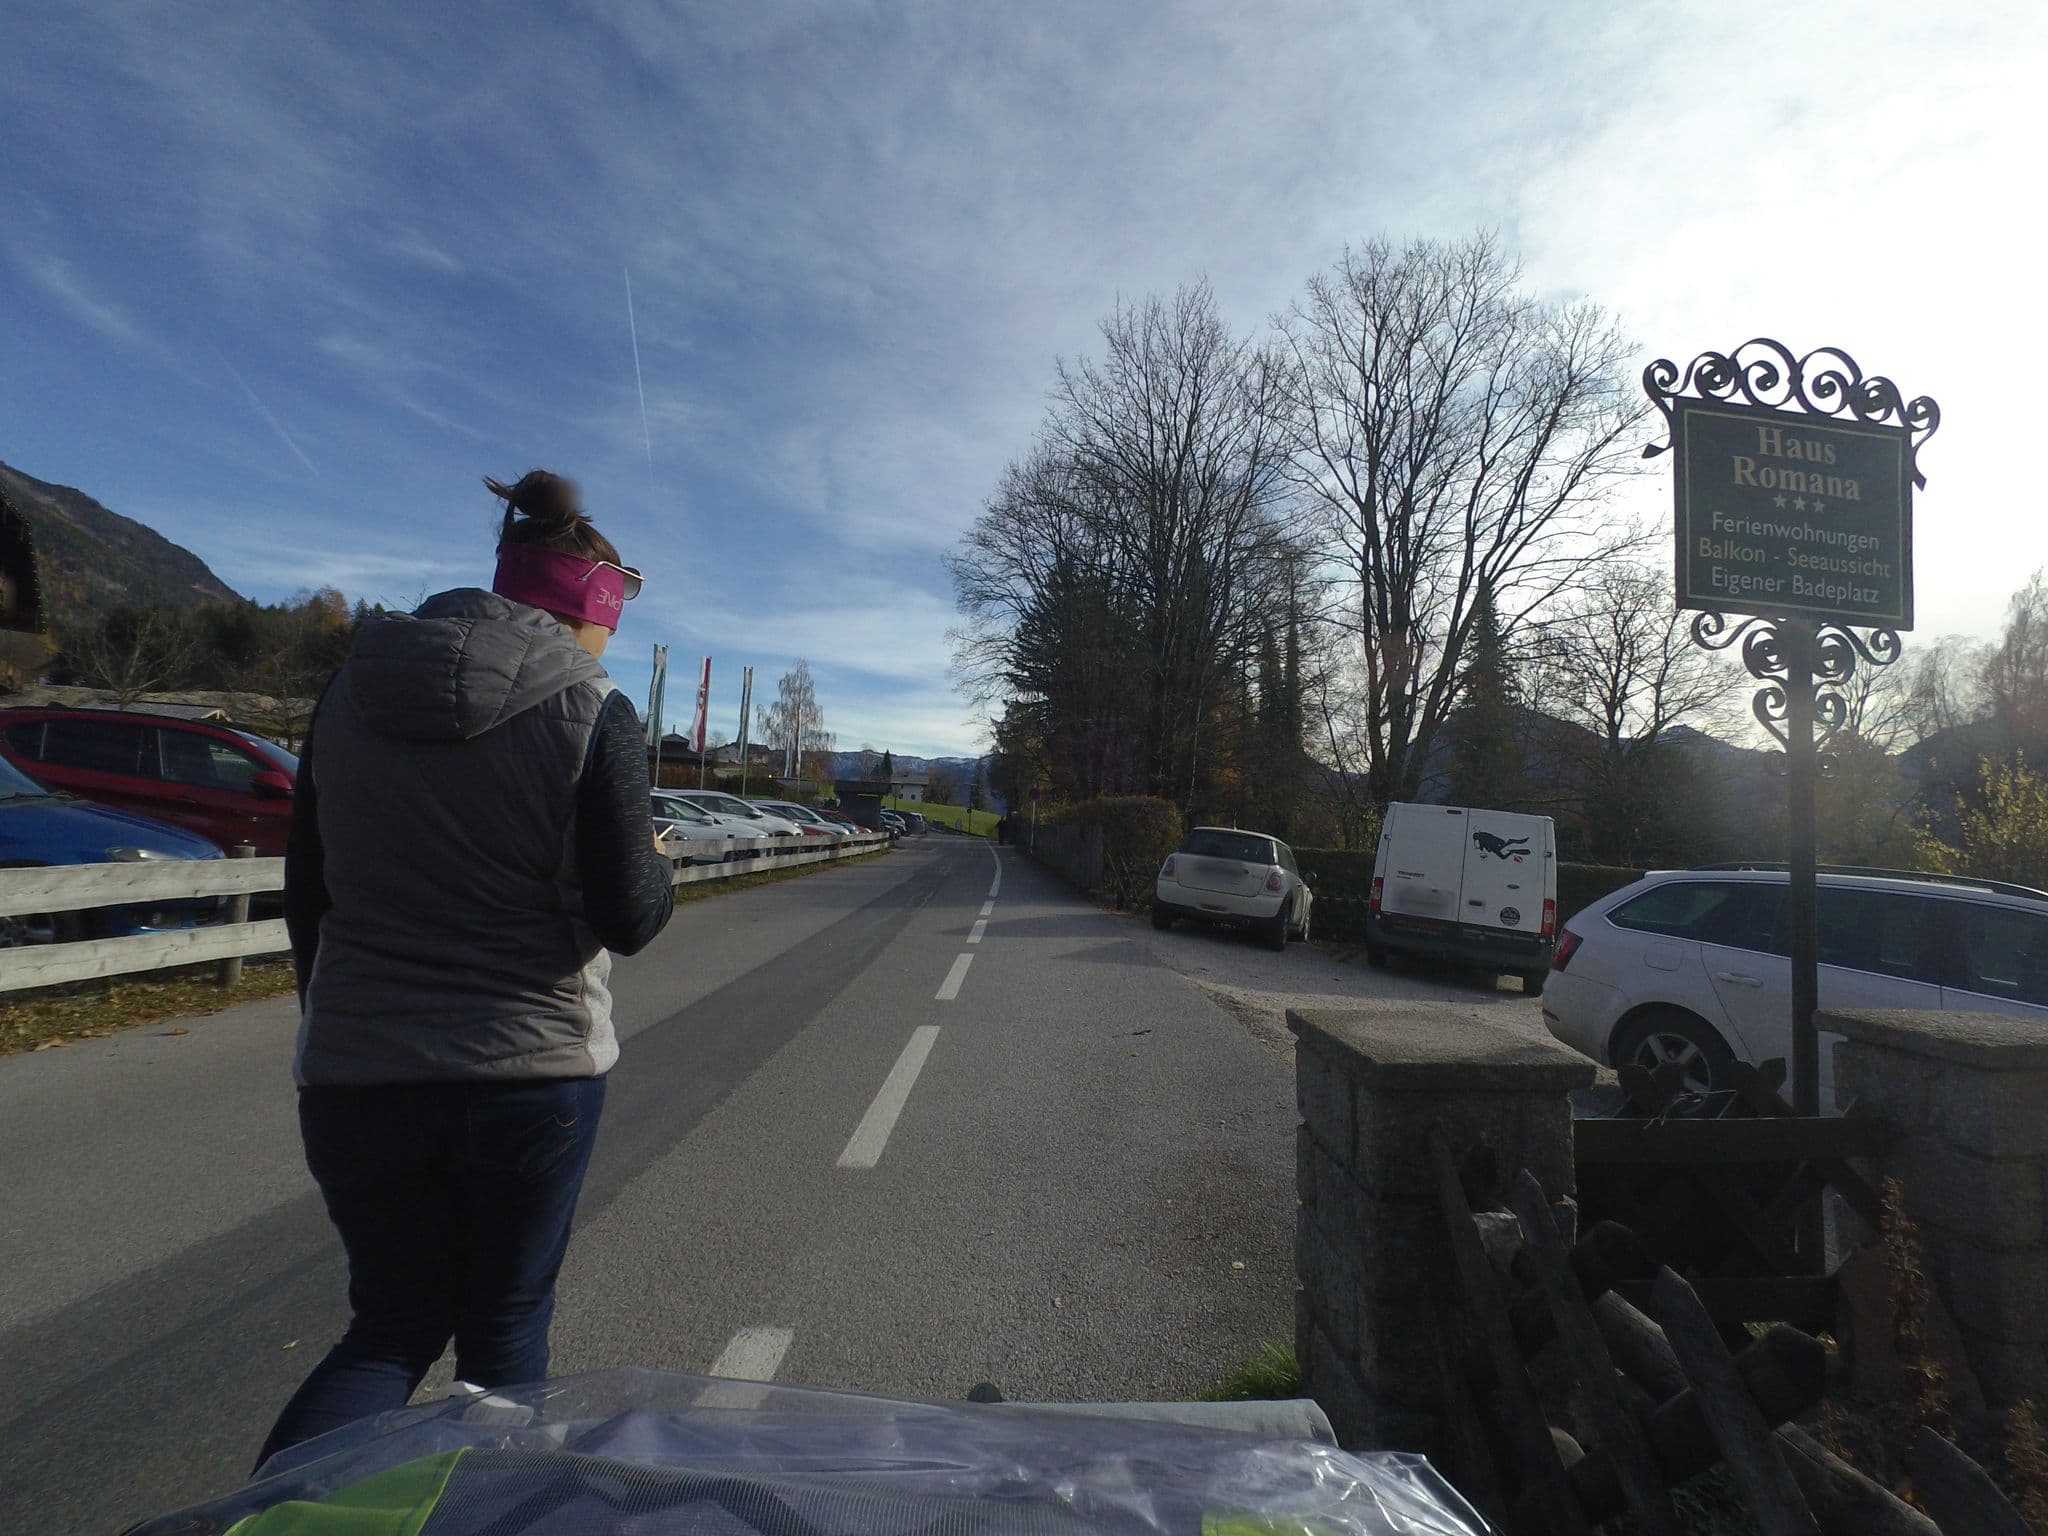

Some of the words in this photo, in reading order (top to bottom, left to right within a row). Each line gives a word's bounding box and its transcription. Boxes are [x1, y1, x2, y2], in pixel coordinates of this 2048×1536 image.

[1756, 426, 1836, 465] Haus
[1732, 455, 1861, 501] Romana
[1712, 511, 1880, 553] Ferienwohnungen
[1700, 537, 1766, 563] Balkon
[1787, 547, 1891, 577] Seeaussicht
[1712, 566, 1785, 594] Eigener
[1792, 574, 1880, 605] Badeplatz
